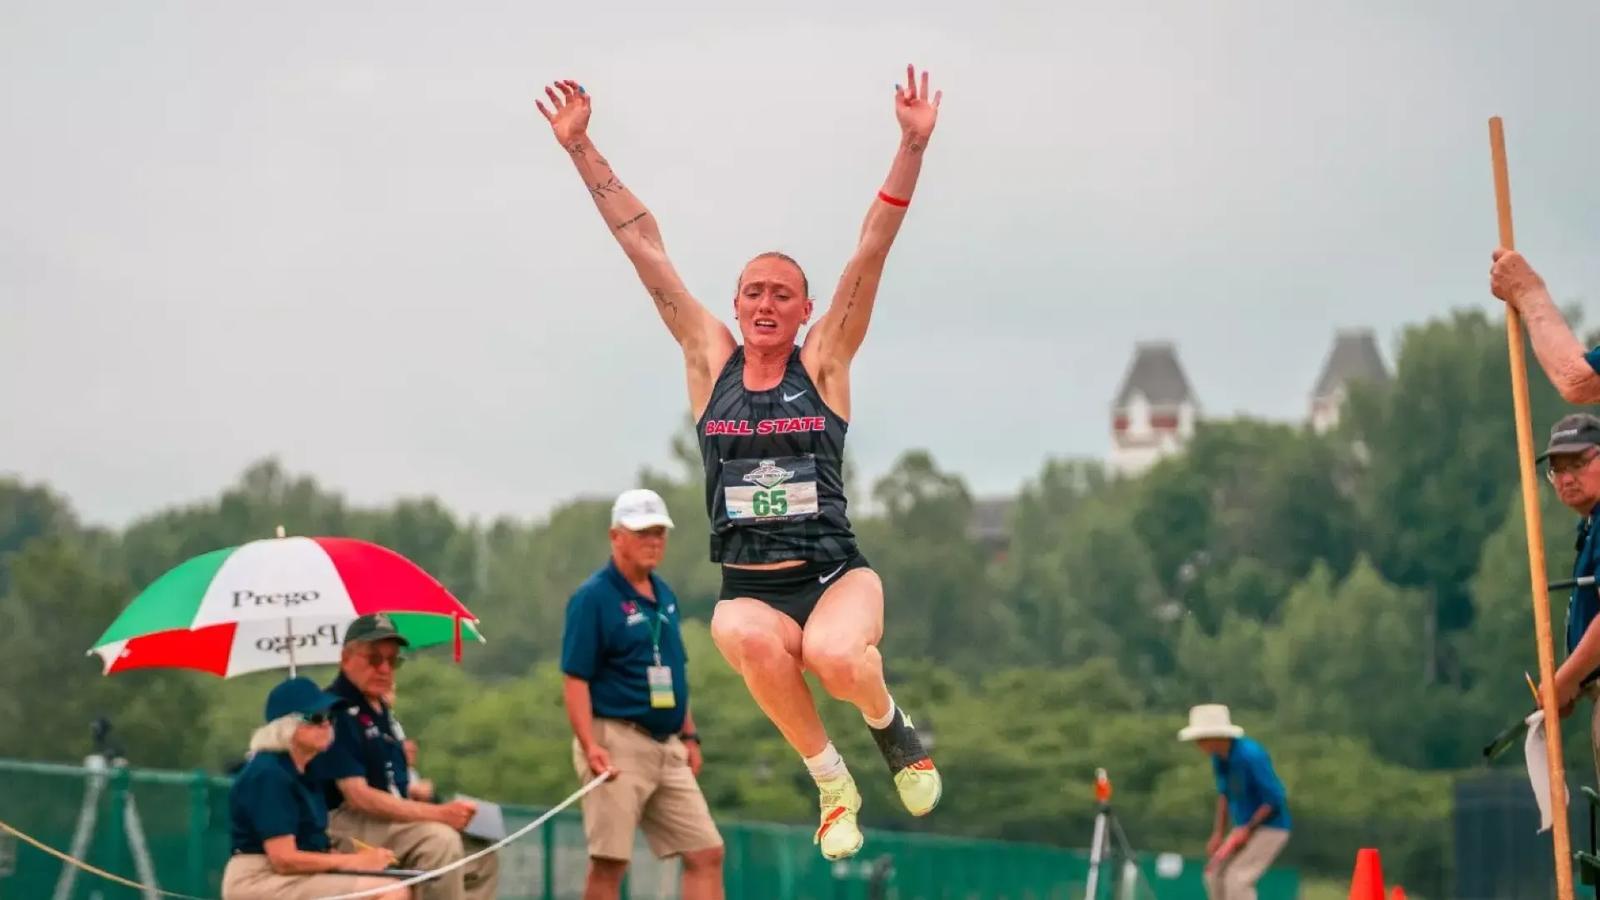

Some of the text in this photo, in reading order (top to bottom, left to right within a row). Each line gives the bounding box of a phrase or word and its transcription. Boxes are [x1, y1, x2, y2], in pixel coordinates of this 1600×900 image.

[705, 416, 826, 436] BALL STATE
[752, 489, 788, 517] 65
[231, 590, 321, 608] Prego
